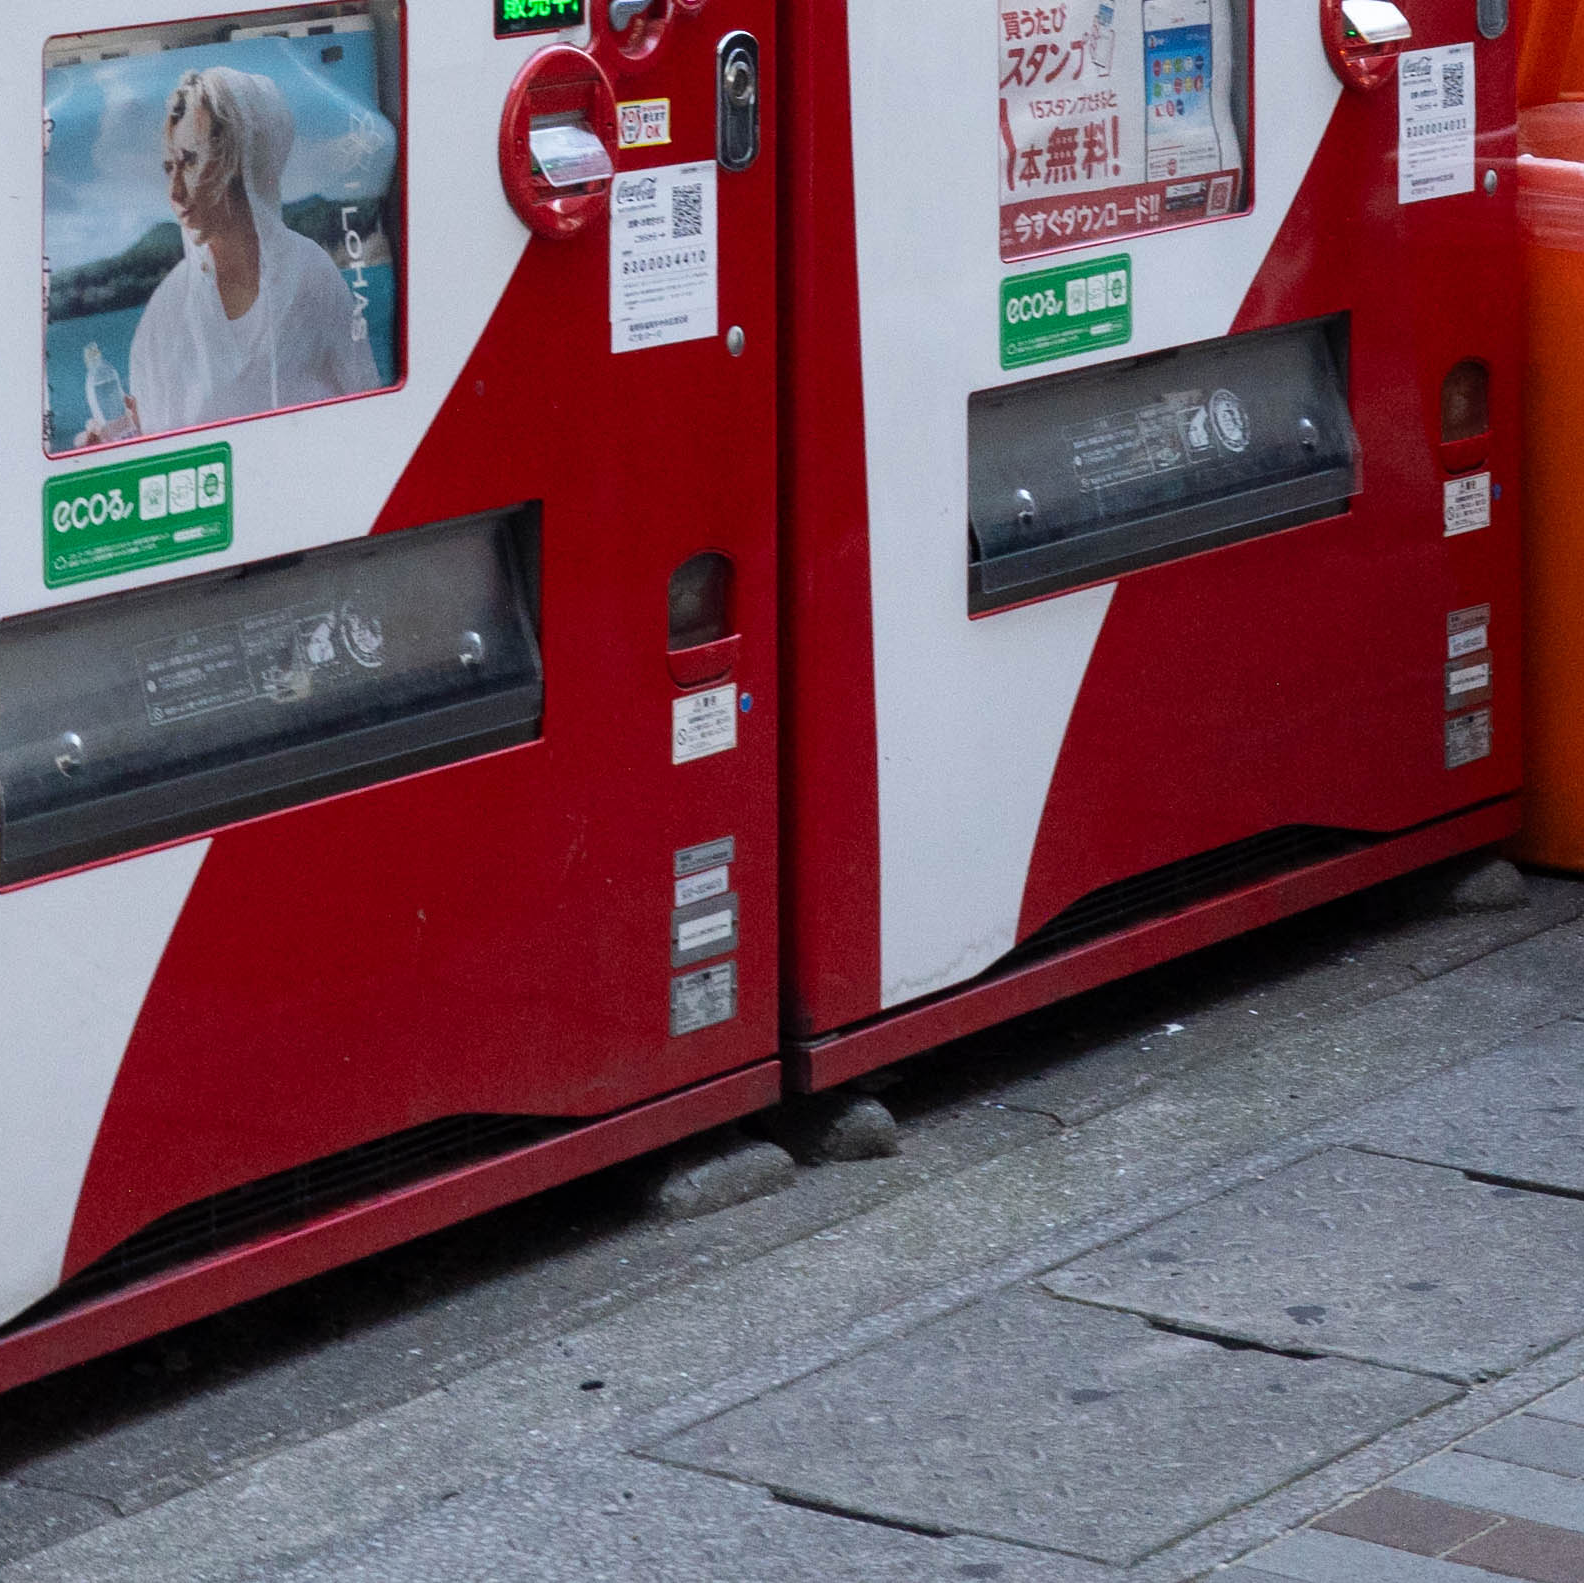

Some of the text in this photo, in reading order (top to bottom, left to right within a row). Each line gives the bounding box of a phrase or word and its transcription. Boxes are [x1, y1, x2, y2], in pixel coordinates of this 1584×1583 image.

[1001, 4, 1067, 41] 買うたび
[999, 32, 1091, 90] スタンプ
[1028, 89, 1118, 120] 15スタンプたまると
[646, 124, 661, 138] OK
[1014, 195, 1162, 243] 今すぐダウンロード!!
[341, 206, 368, 343] LOHAS
